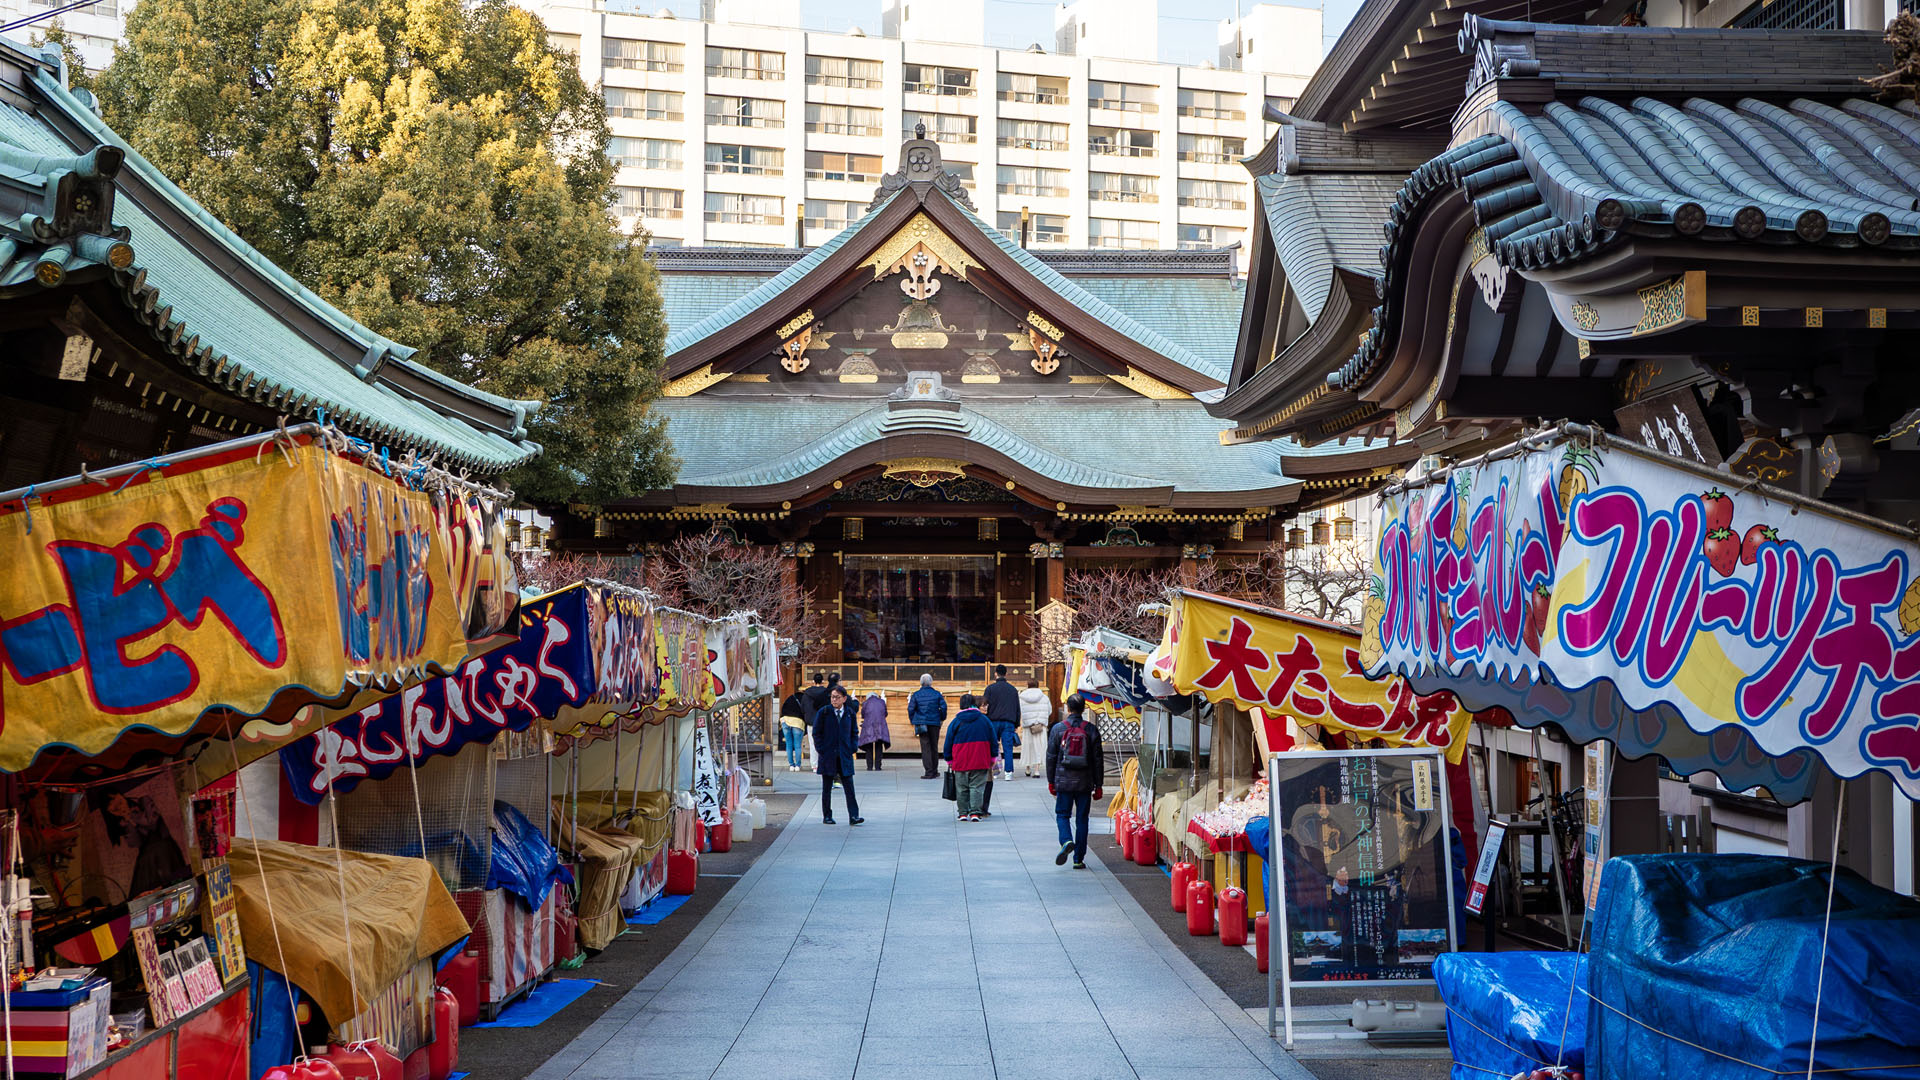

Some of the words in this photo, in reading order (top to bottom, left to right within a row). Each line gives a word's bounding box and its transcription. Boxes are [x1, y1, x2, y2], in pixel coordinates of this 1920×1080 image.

[1352, 757, 1375, 887] お江戸の天神信仰
